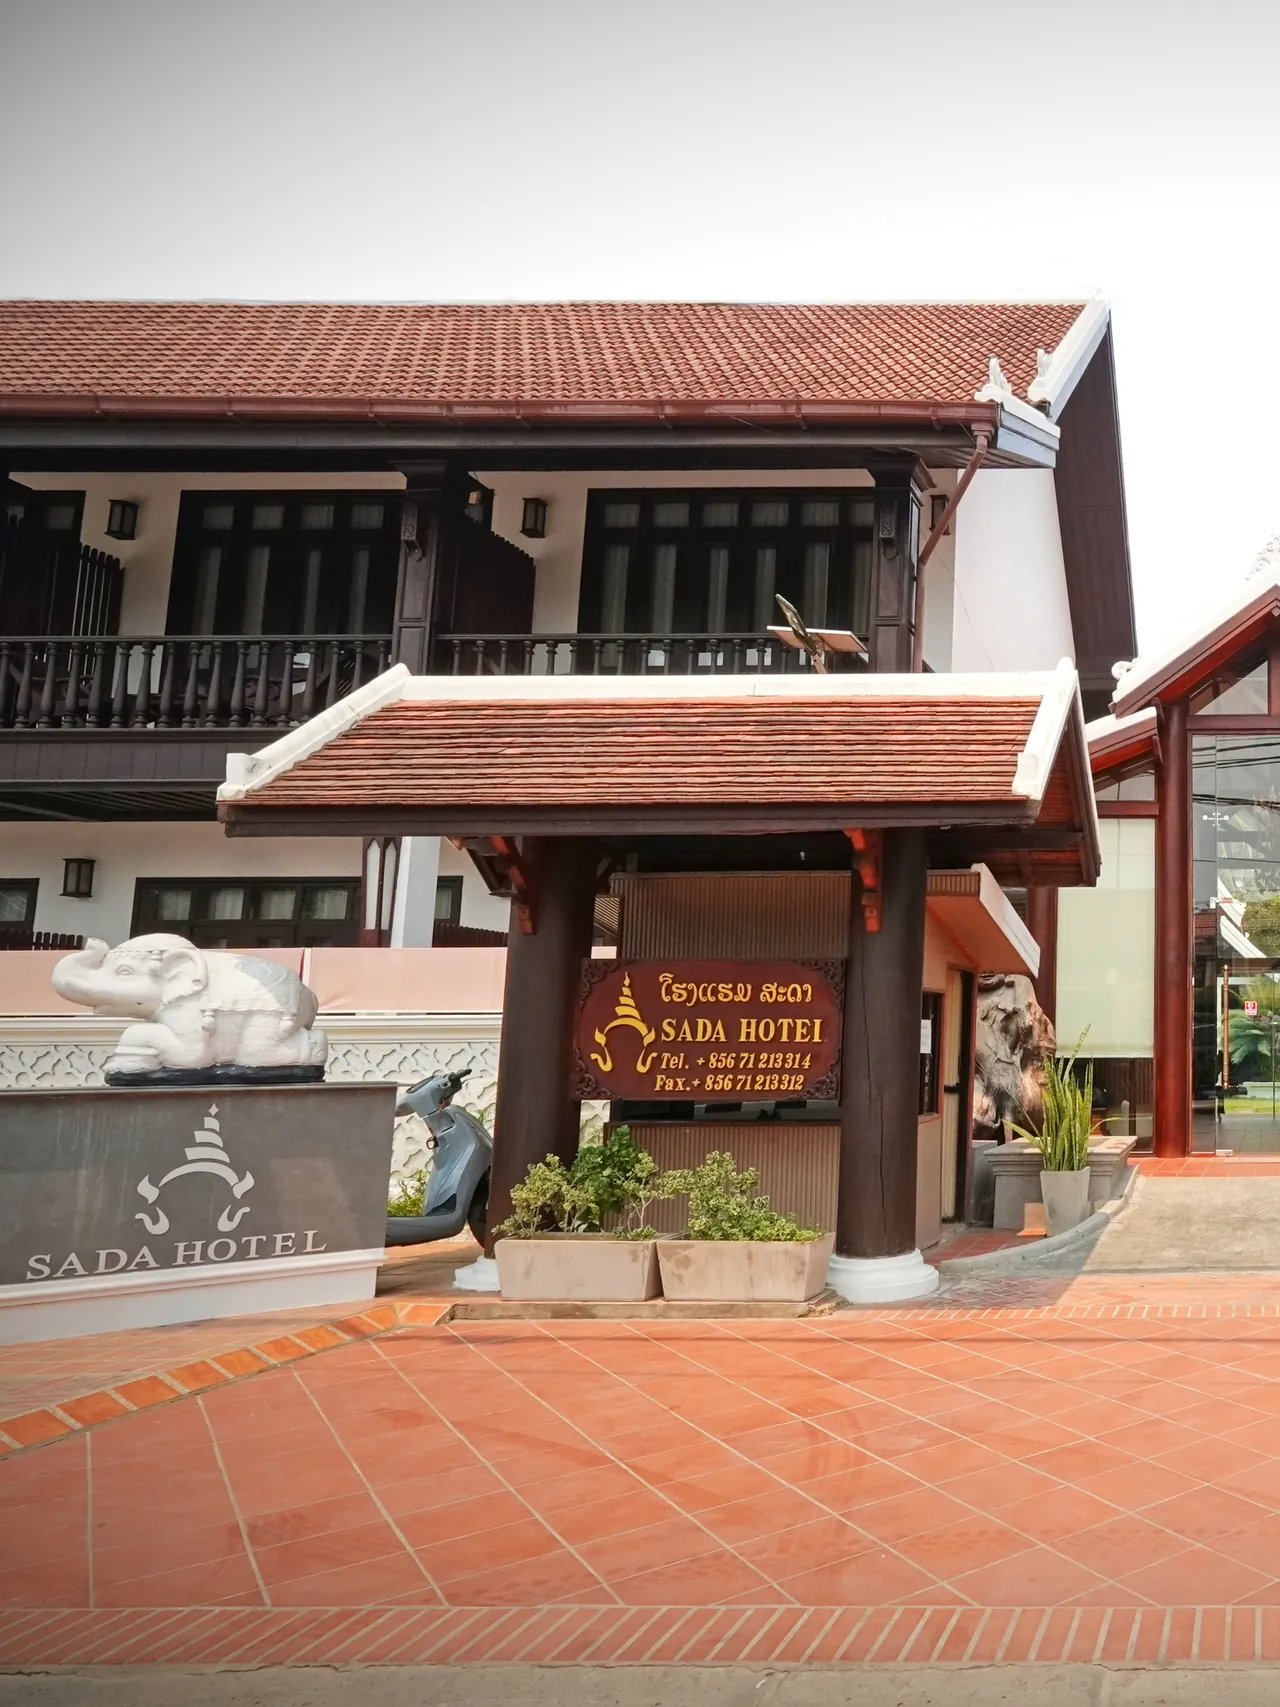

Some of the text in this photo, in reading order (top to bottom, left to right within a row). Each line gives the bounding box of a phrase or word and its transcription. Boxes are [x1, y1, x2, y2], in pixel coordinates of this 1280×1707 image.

[661, 1018, 728, 1042] SADA
[660, 1052, 689, 1070] Tel.
[25, 1230, 328, 1280] SADA HOTEL
